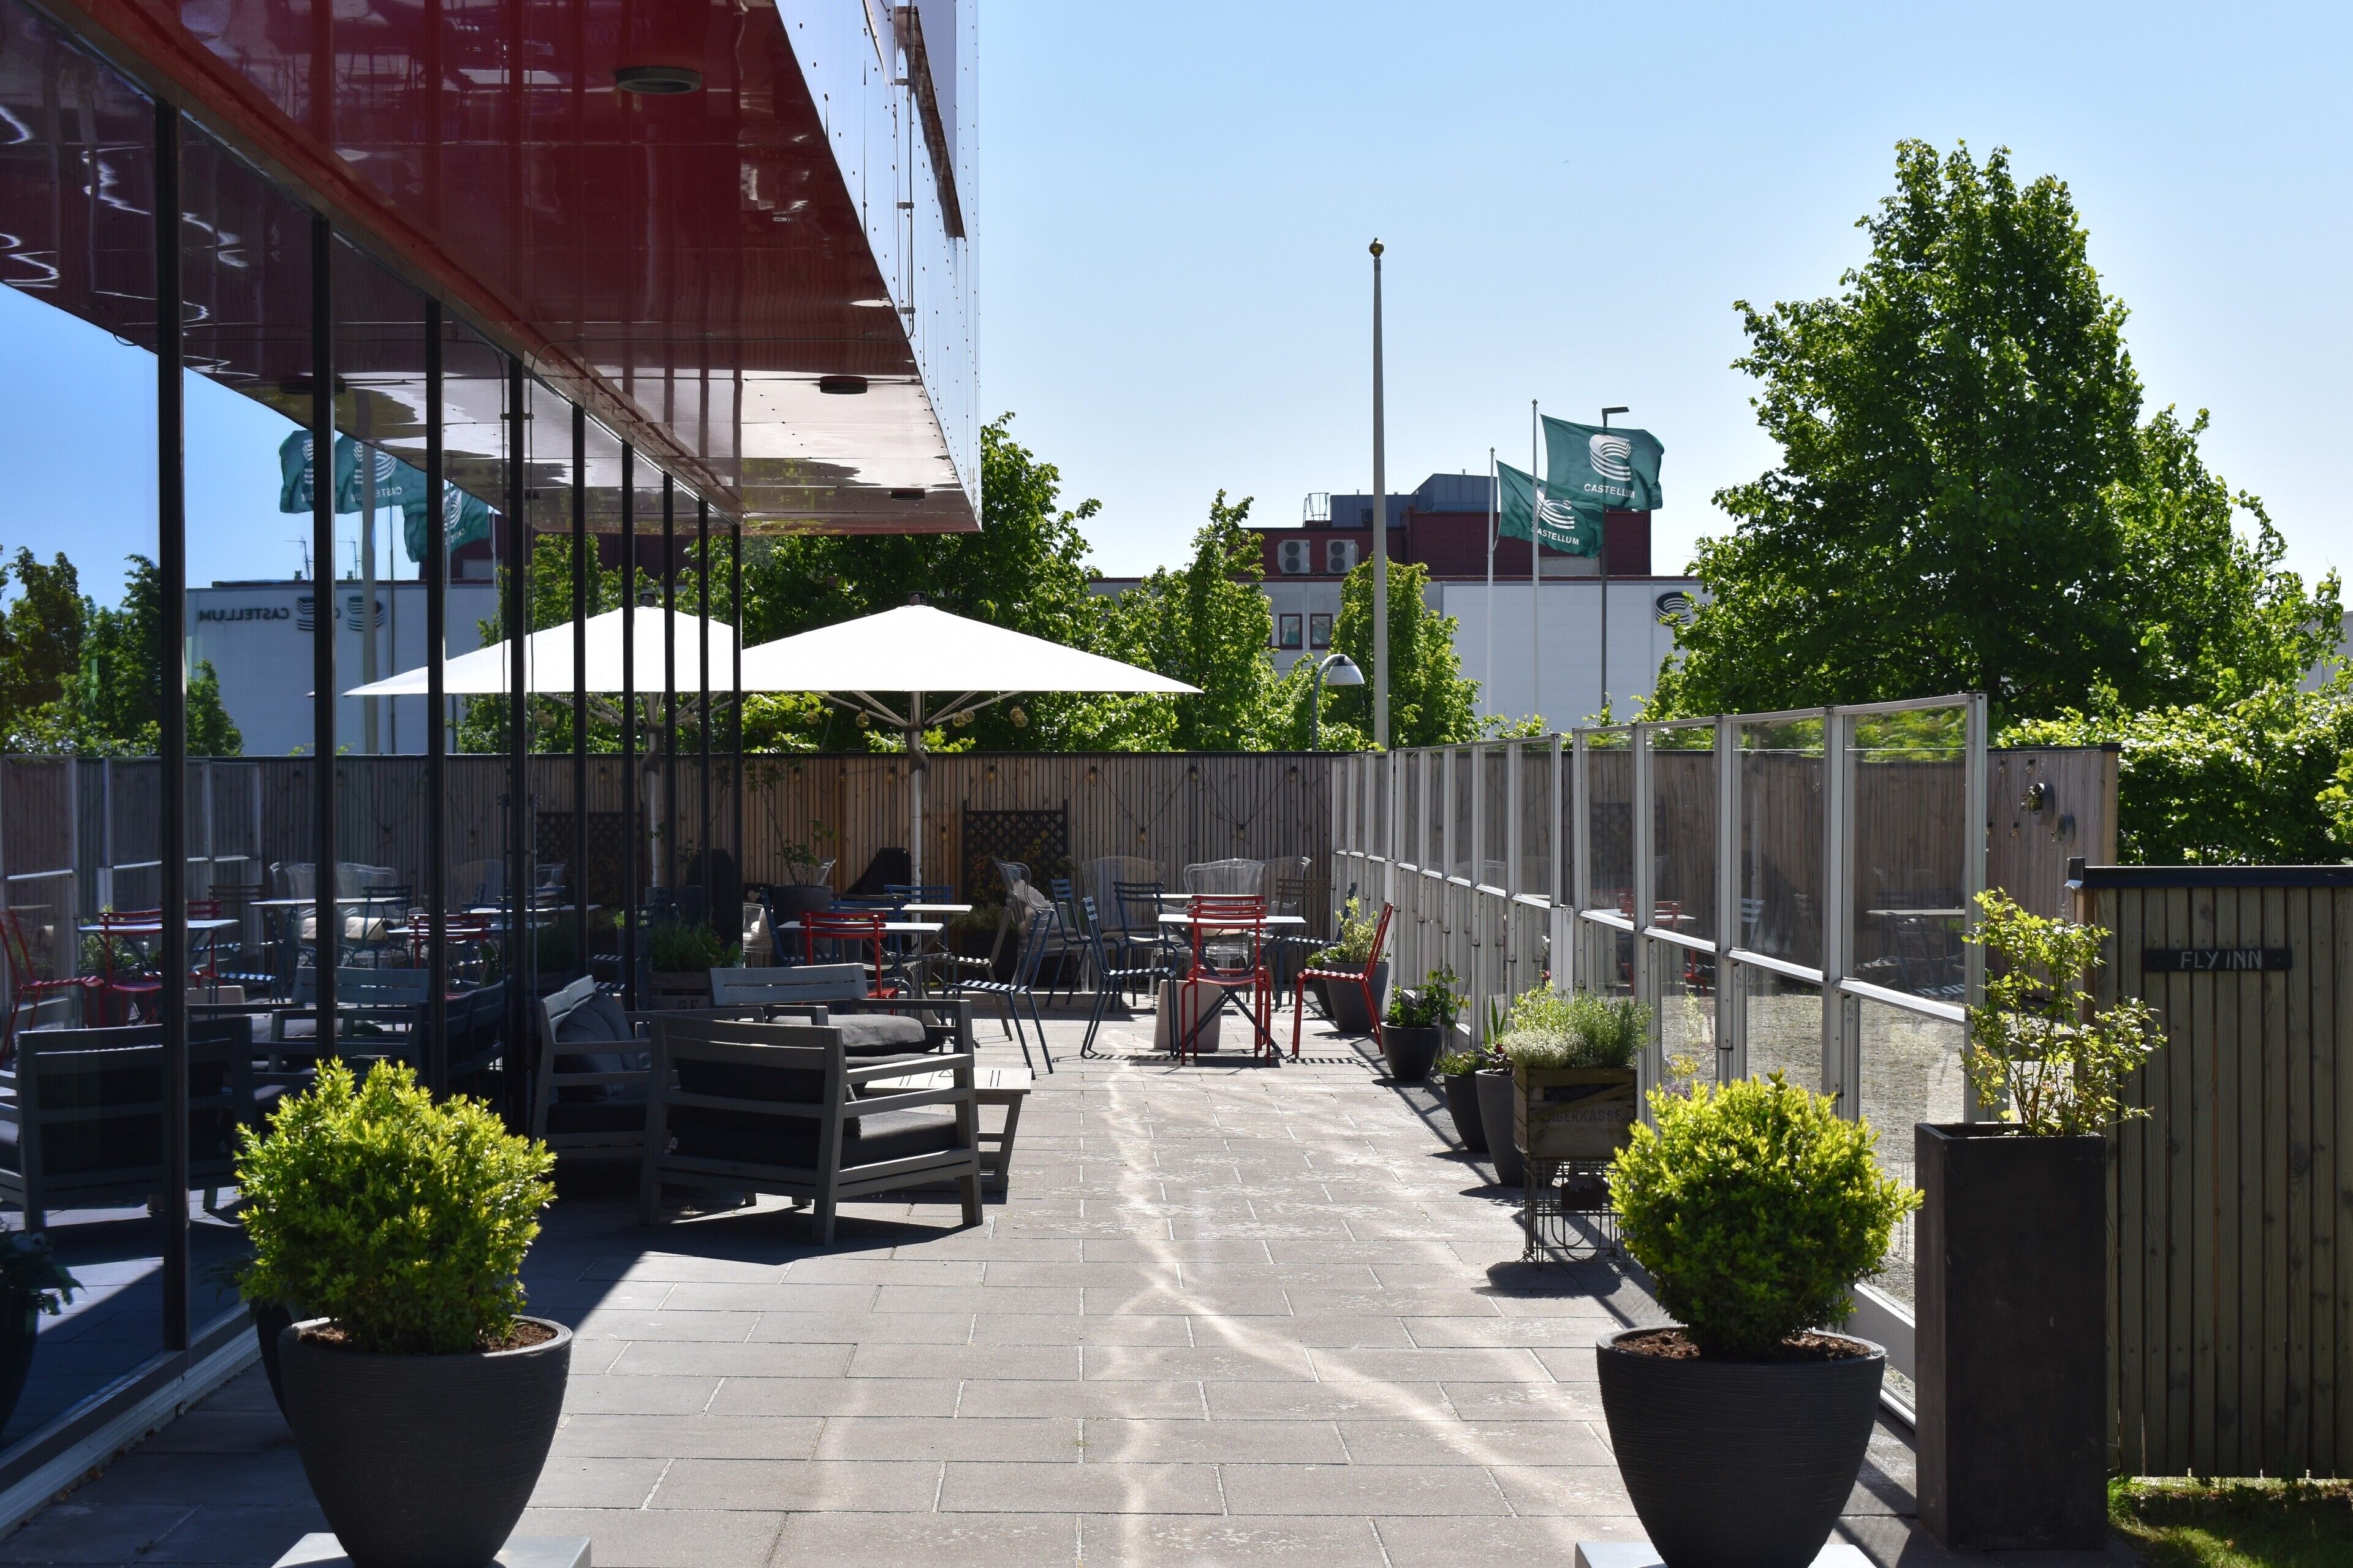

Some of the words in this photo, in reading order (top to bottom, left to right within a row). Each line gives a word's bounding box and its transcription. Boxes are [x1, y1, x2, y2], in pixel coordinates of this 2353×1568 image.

[1584, 483, 1635, 499] CASTELLUM
[2180, 950, 2219, 969] FLY
[2226, 950, 2262, 970] INN
